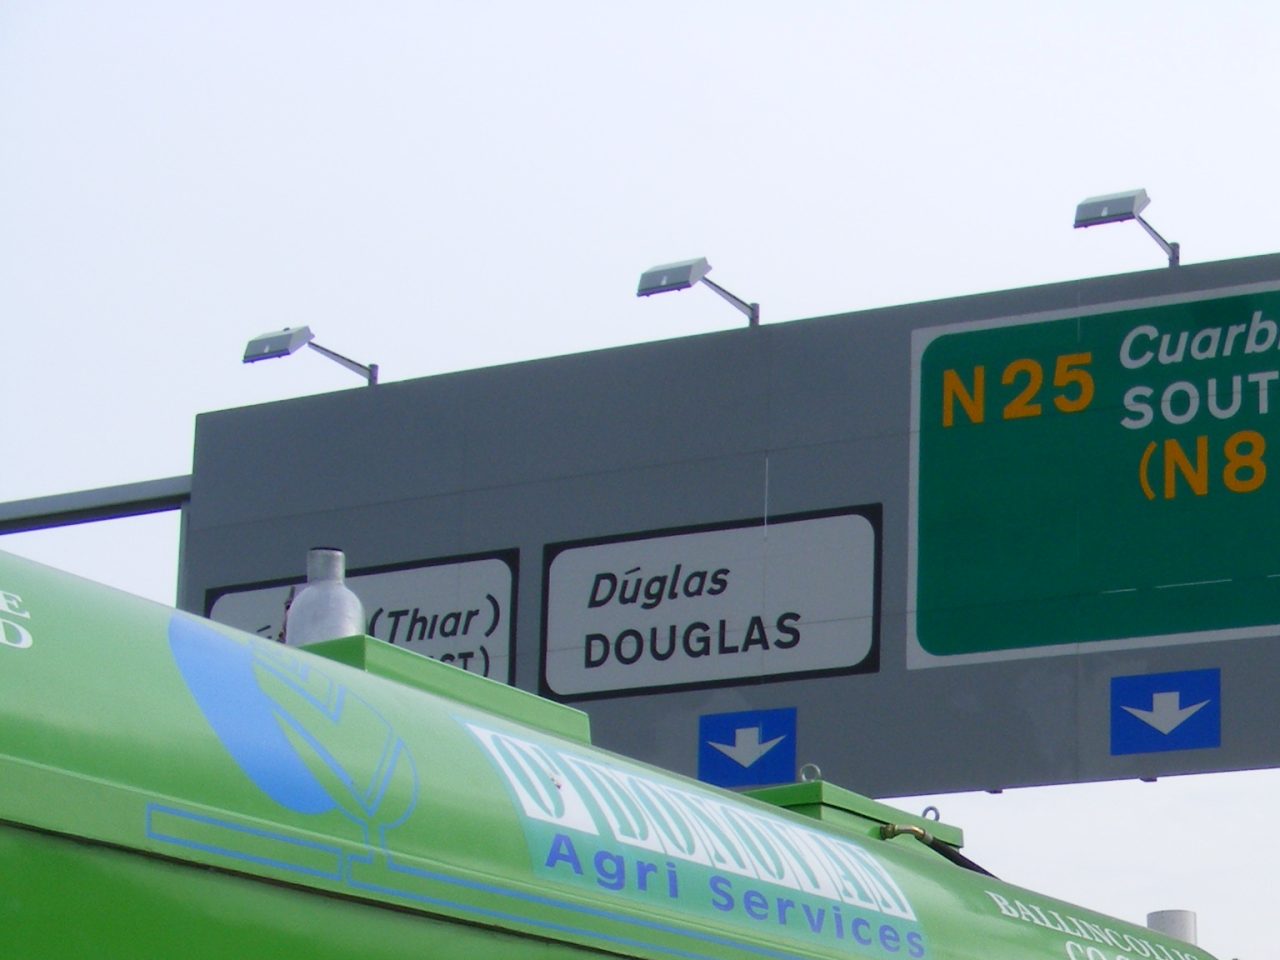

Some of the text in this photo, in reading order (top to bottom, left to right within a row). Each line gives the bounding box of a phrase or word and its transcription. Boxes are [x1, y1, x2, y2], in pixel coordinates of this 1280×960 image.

[942, 352, 1095, 428] N25
[587, 564, 730, 610] Dúglas
[584, 611, 801, 669] DOUGLAS
[545, 833, 926, 960] Agri Services
